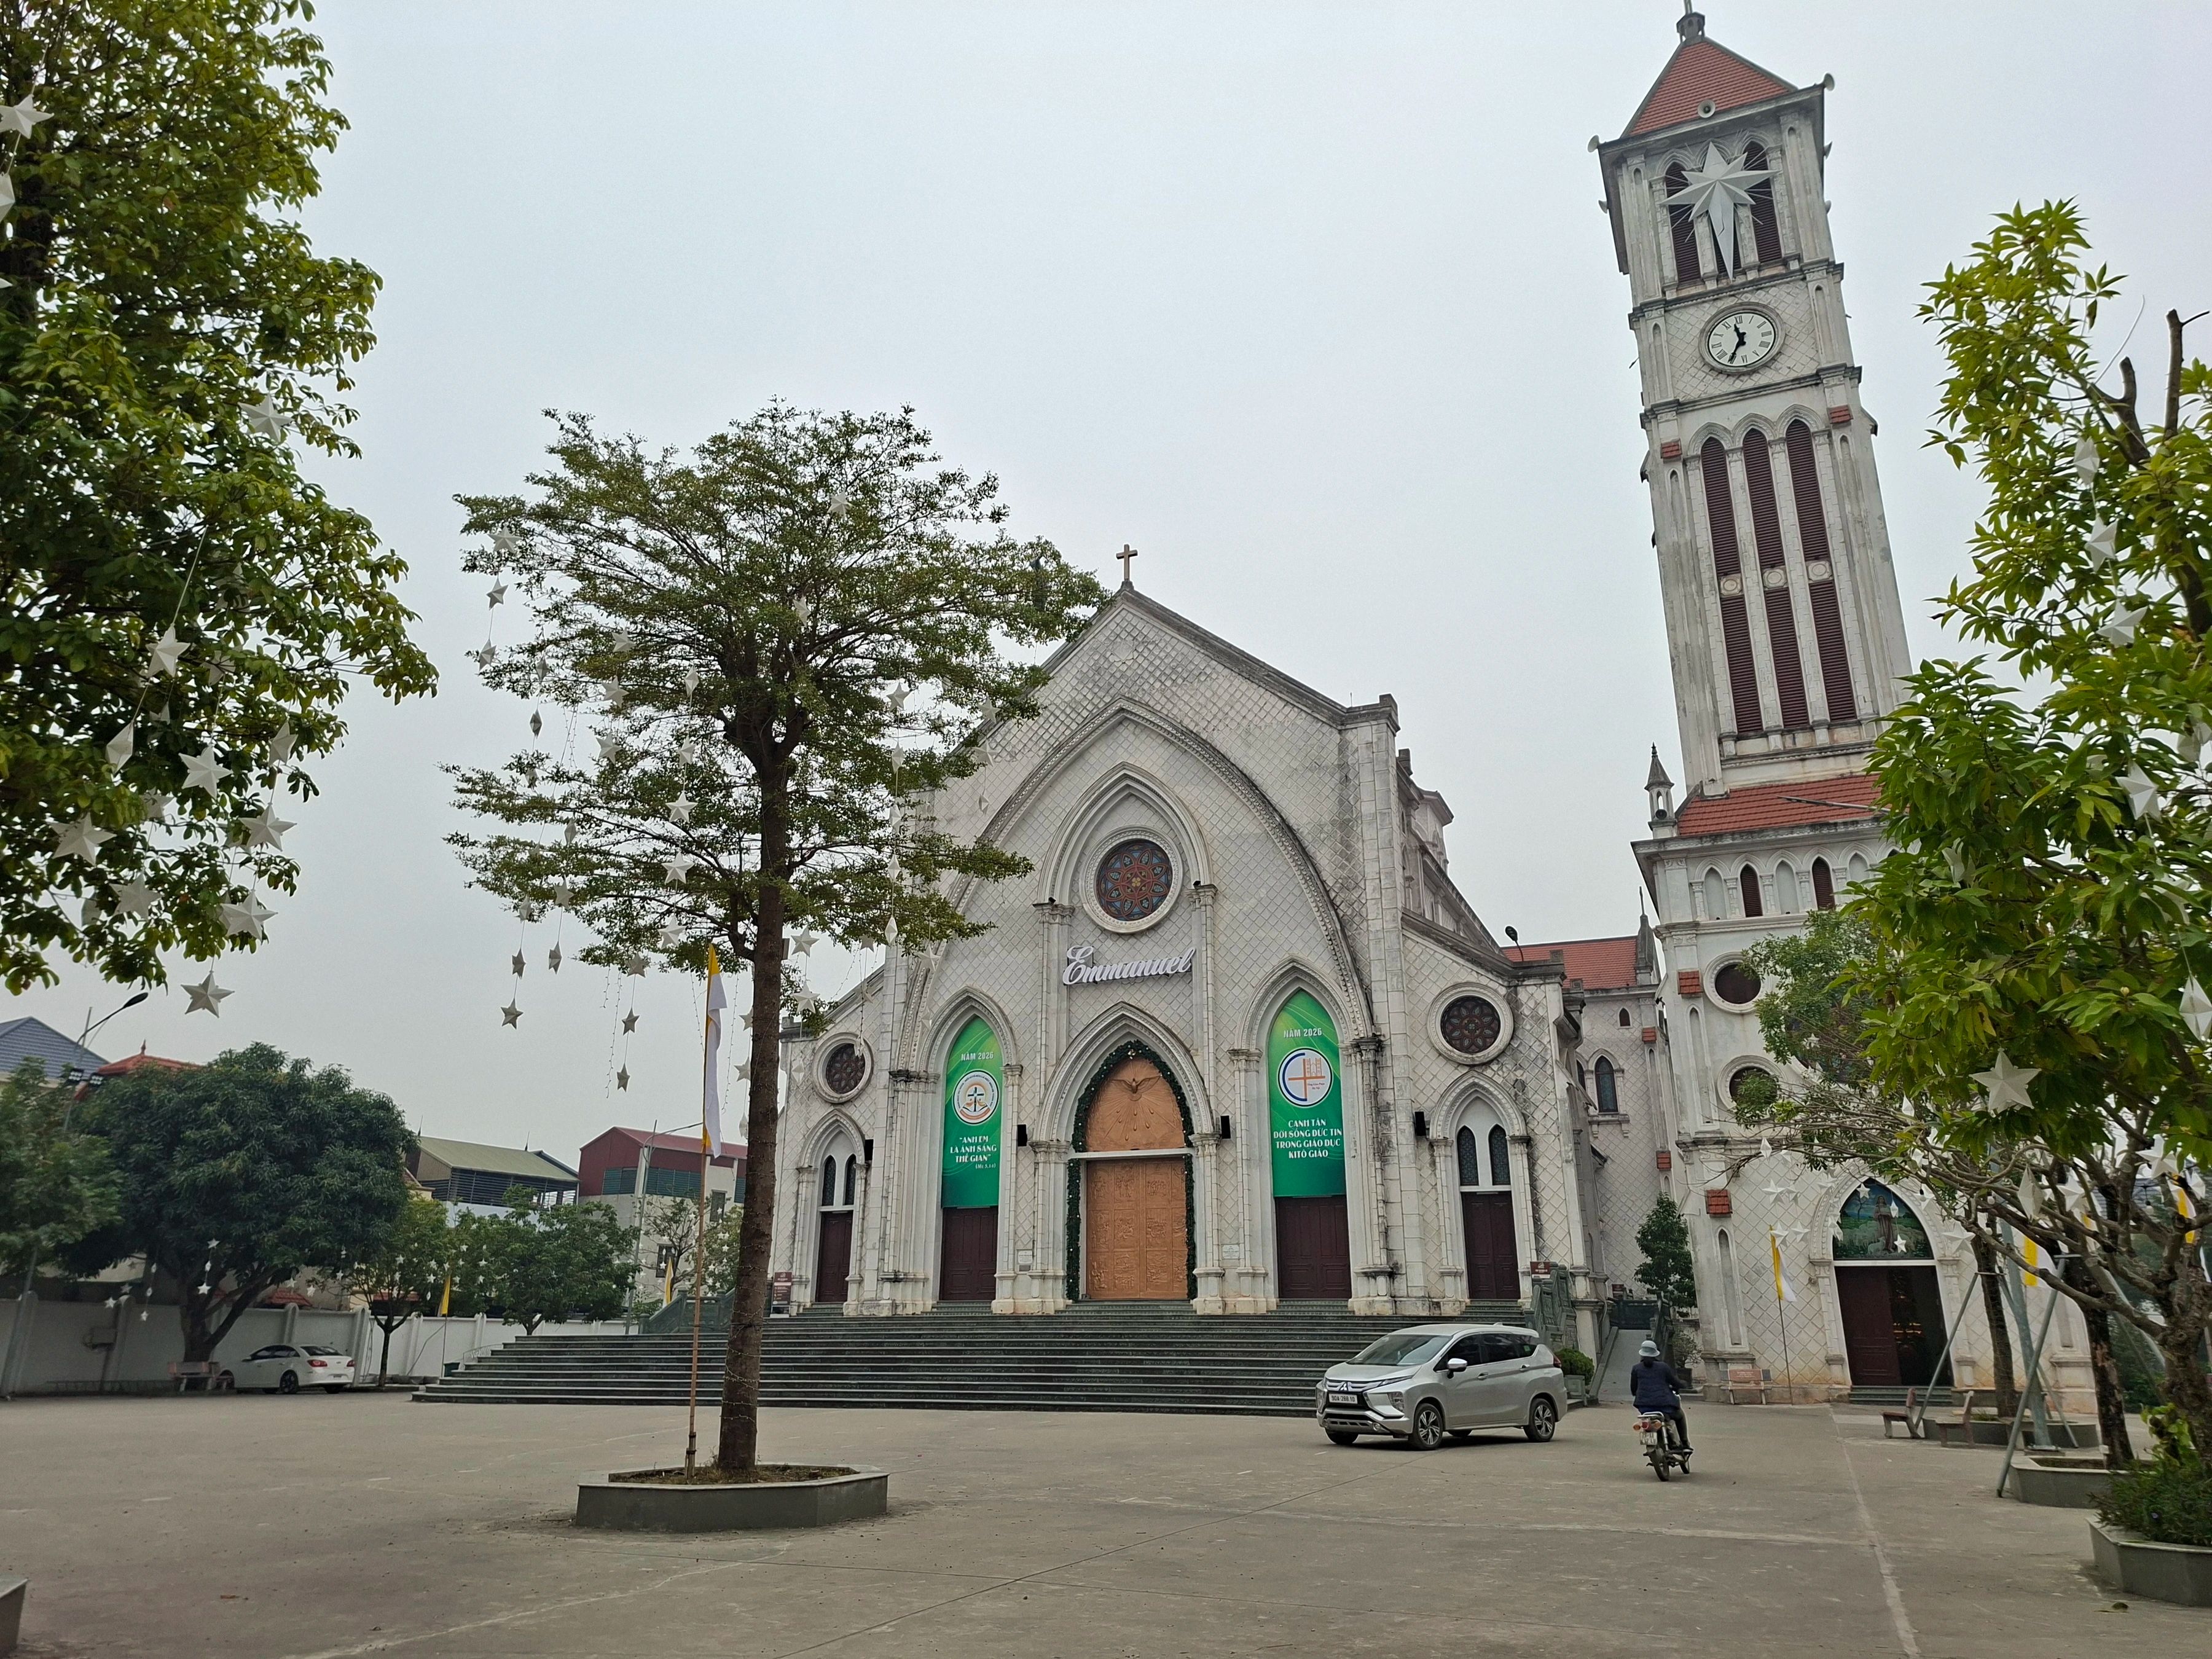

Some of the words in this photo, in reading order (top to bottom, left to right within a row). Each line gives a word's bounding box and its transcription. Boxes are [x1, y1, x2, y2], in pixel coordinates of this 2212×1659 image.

[1722, 321, 1732, 330] XI
[1062, 945, 1196, 985] Emmanuel
[1284, 1029, 1301, 1038] NĂM
[1303, 1027, 1322, 1037] 2026
[978, 1051, 994, 1060] 2026
[950, 1145, 959, 1153] LÀ
[960, 1144, 976, 1153] ÁNH
[976, 1143, 997, 1153] SÁNG
[1276, 1140, 1302, 1149] TRONG
[1303, 1138, 1324, 1148] GIÁO
[1324, 1139, 1341, 1148] DỤC
[1288, 1148, 1307, 1159] KITÔ
[1308, 1148, 1328, 1158] GIÁO
